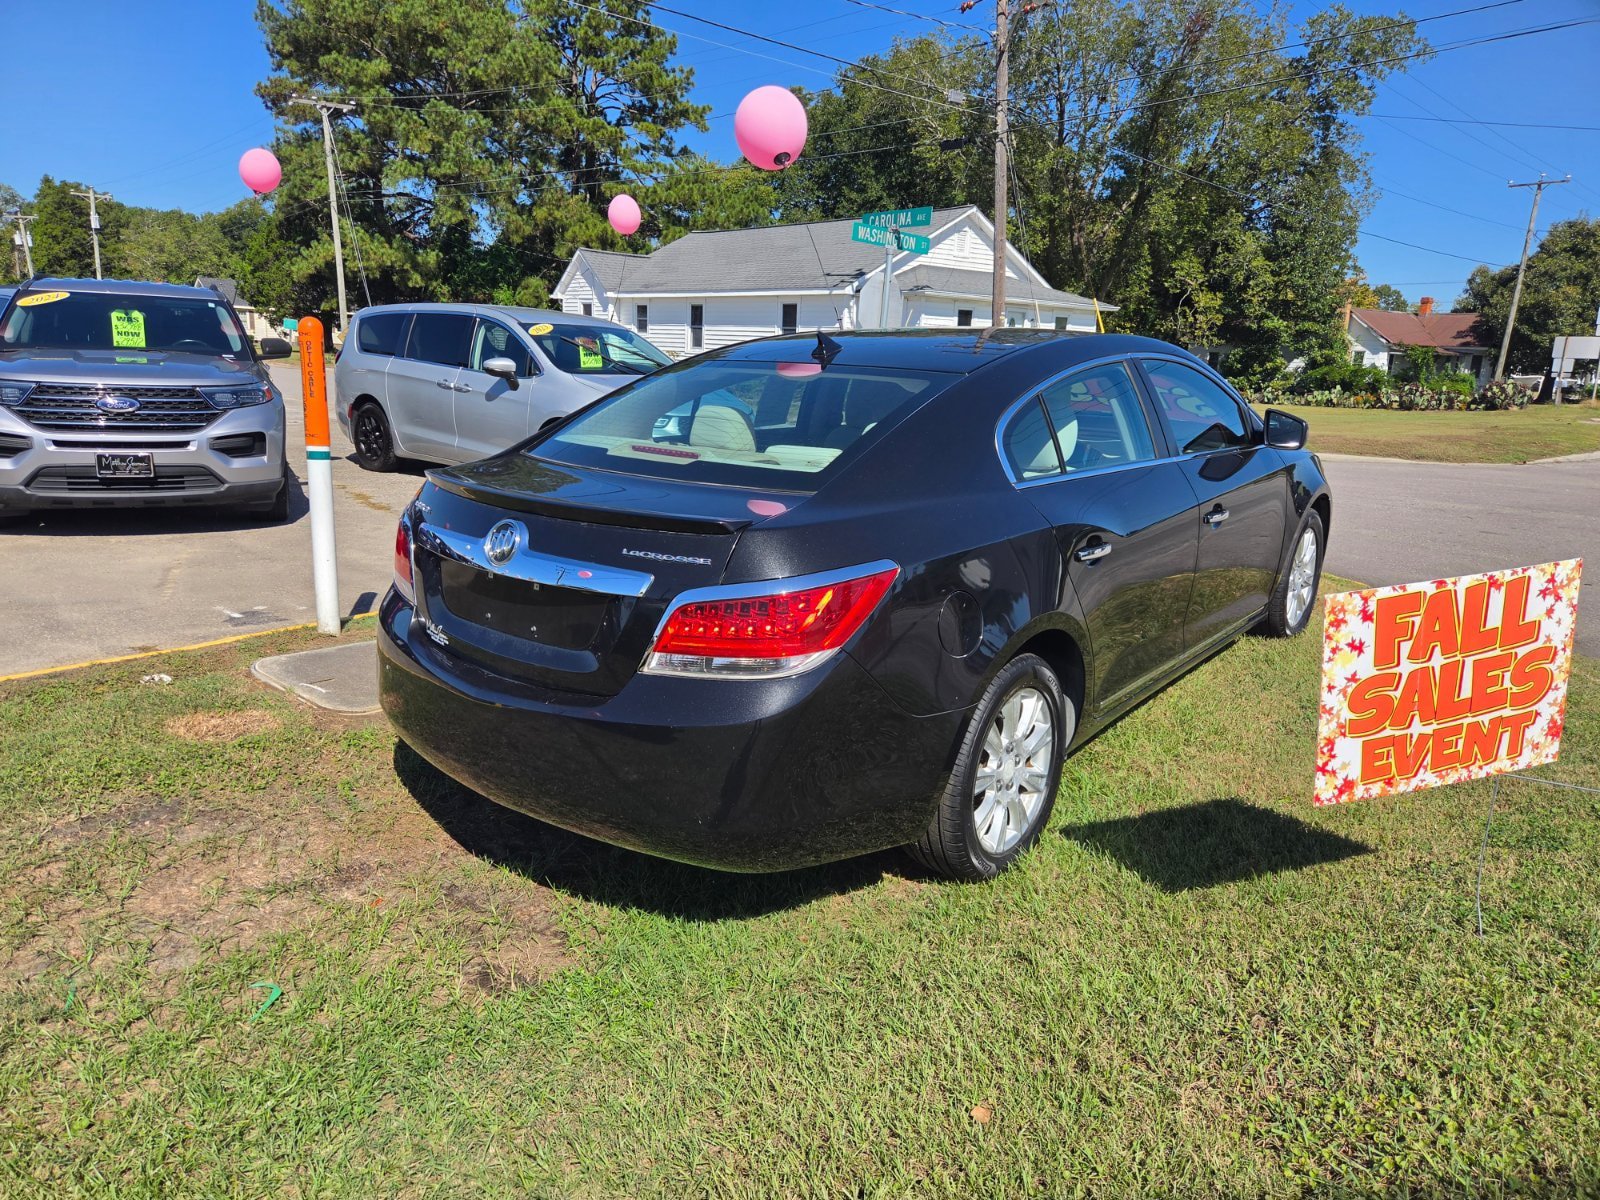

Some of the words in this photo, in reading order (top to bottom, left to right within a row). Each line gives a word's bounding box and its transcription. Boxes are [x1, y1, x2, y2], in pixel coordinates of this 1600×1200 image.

[869, 211, 912, 228] CAROLINA
[917, 213, 926, 221] AVE
[1373, 574, 1541, 670] FALL
[1346, 645, 1557, 738] SALES
[1359, 710, 1537, 785] EVENT
